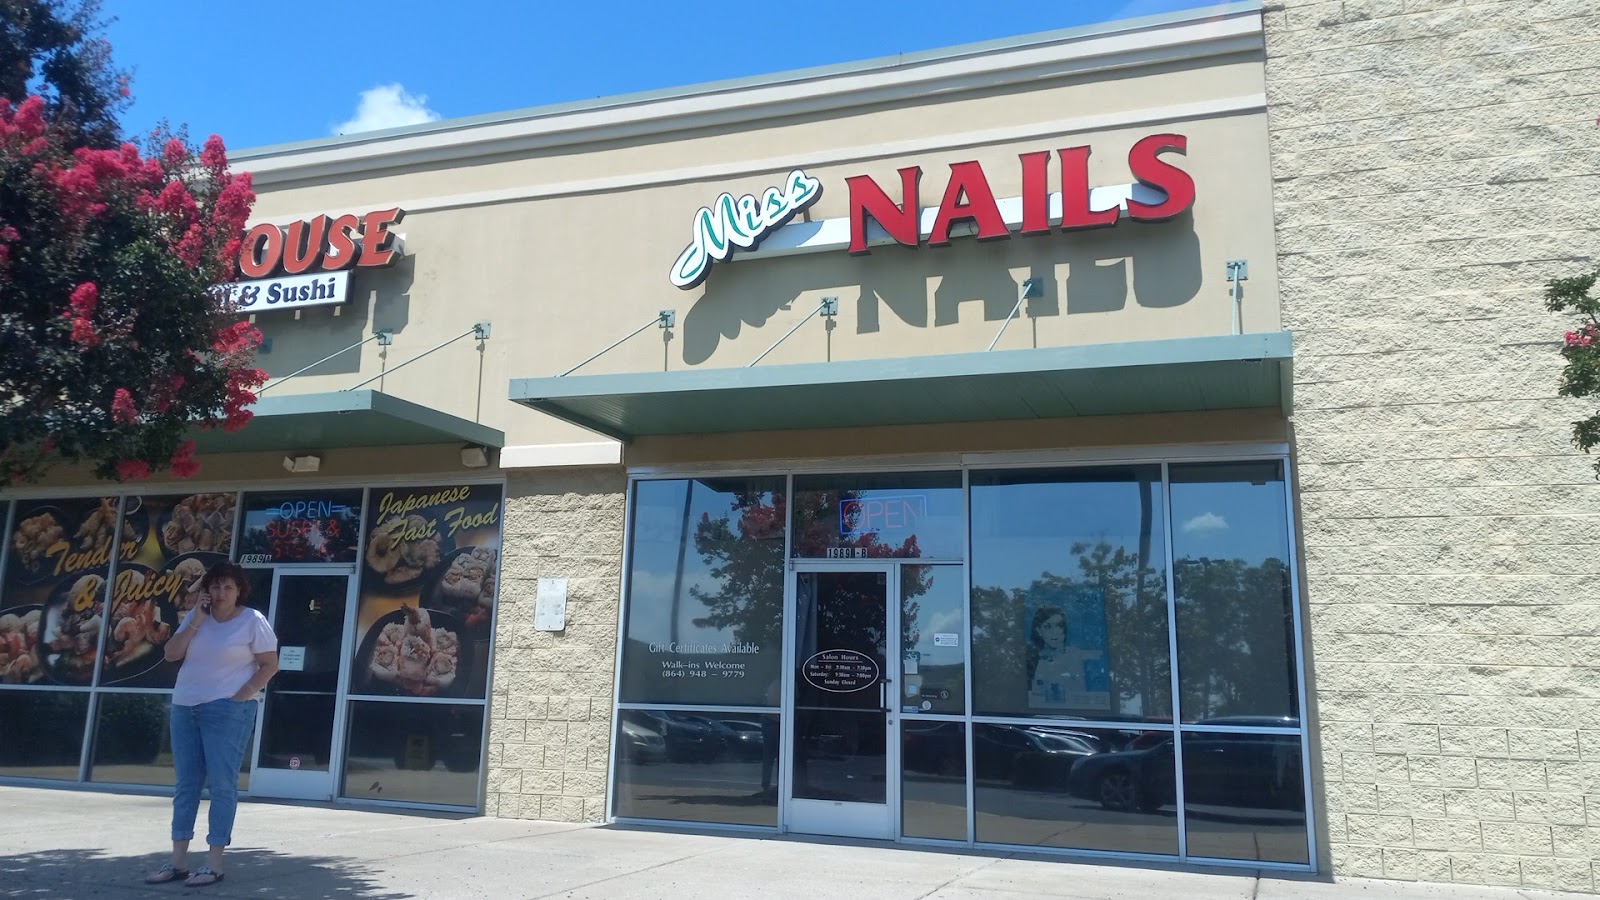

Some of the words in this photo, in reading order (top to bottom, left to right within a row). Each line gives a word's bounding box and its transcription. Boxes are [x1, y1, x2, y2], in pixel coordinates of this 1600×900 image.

[669, 170, 822, 288] Miss
[844, 133, 1196, 255] NAILS
[239, 208, 405, 278] OUSE
[238, 285, 260, 306] &
[266, 277, 336, 304] Sushi
[280, 501, 332, 519] OPEN
[376, 485, 471, 525] Japanese
[844, 499, 923, 530] OPEN
[387, 518, 438, 549] Fast
[444, 502, 499, 538] Food
[46, 536, 138, 576] Tendr
[74, 579, 97, 612] &
[112, 569, 184, 614] Juicy
[648, 642, 665, 654] Gift
[669, 642, 717, 654] Certificates
[722, 642, 760, 654] Available
[662, 661, 700, 669] Walk-ins
[704, 661, 746, 670] Welcome
[662, 670, 685, 678] (864)
[690, 670, 707, 678] 948
[722, 670, 745, 678] 9779
